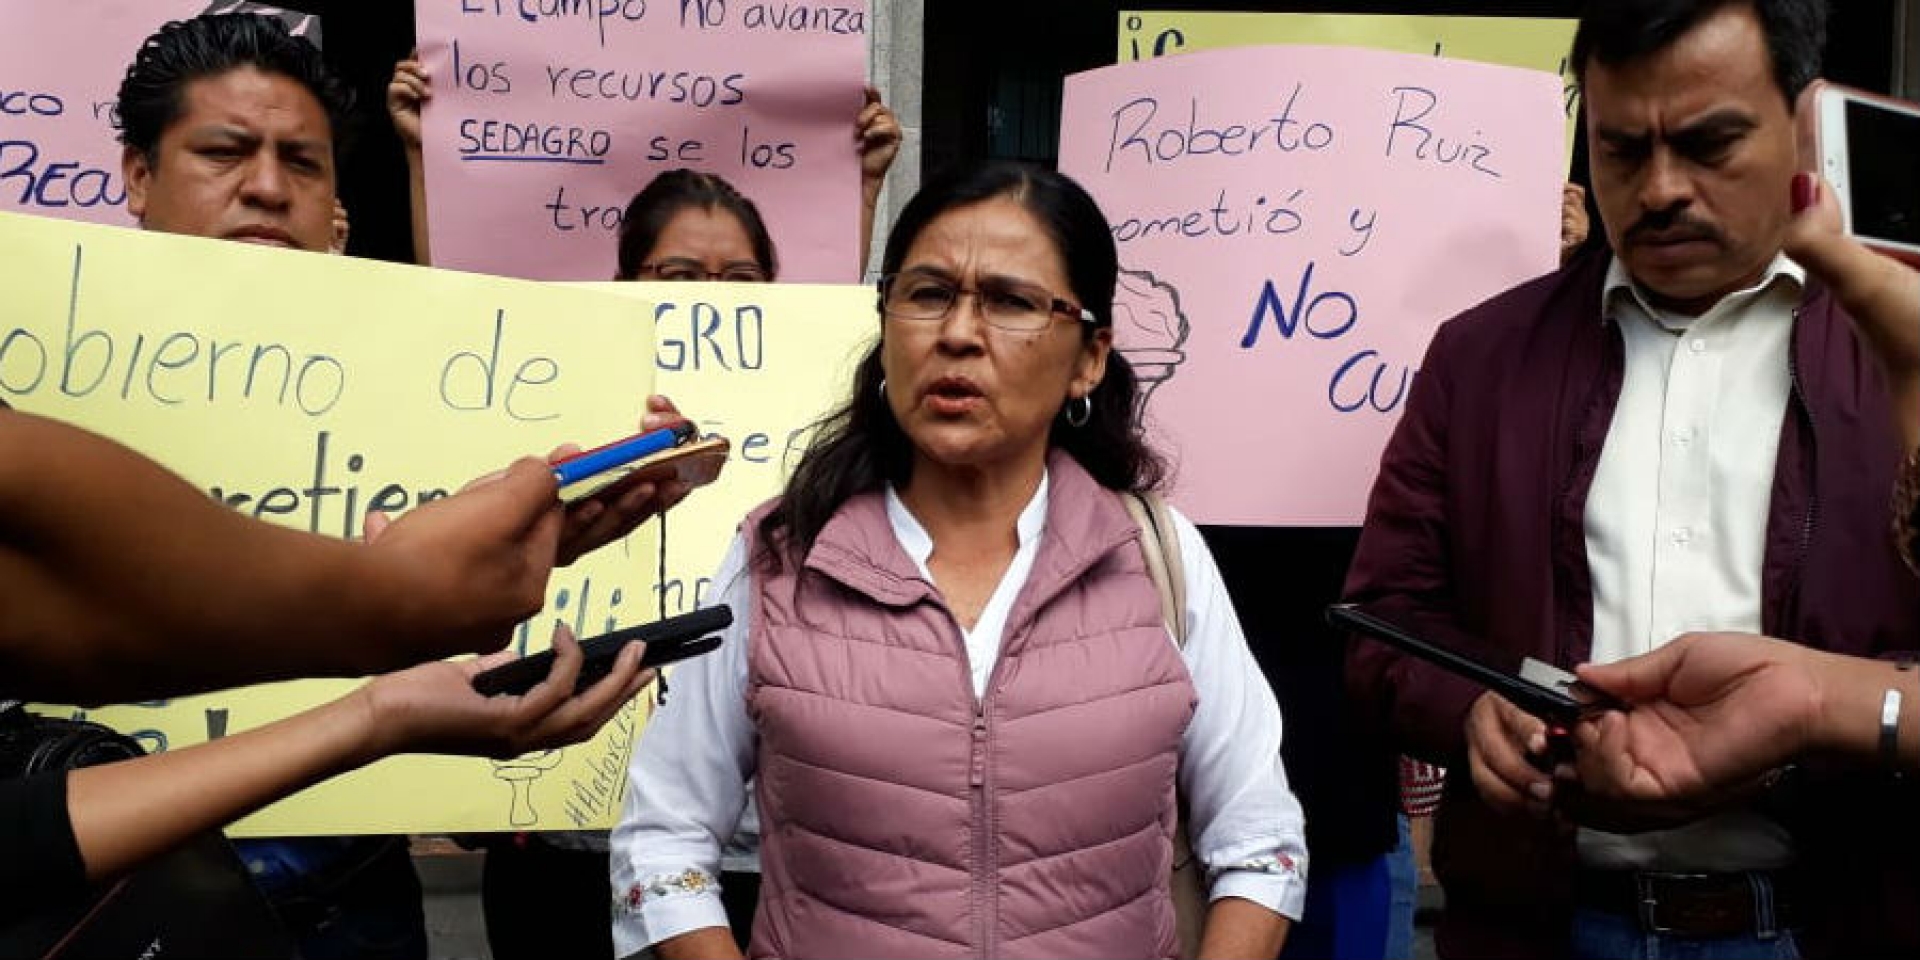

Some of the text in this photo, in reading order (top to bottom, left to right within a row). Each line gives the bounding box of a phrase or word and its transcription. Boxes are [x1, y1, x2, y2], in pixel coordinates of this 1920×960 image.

[743, 3, 865, 35] avanza
[453, 38, 744, 107] los recursos
[0, 91, 63, 116] co
[1105, 82, 1333, 173] Roberto
[1386, 87, 1501, 177] Ruiz
[458, 118, 796, 170] SEDAGRO se los
[545, 186, 627, 231] tra
[1339, 207, 1376, 256] y
[0, 243, 561, 421] obierno de
[655, 302, 763, 372] GRO
